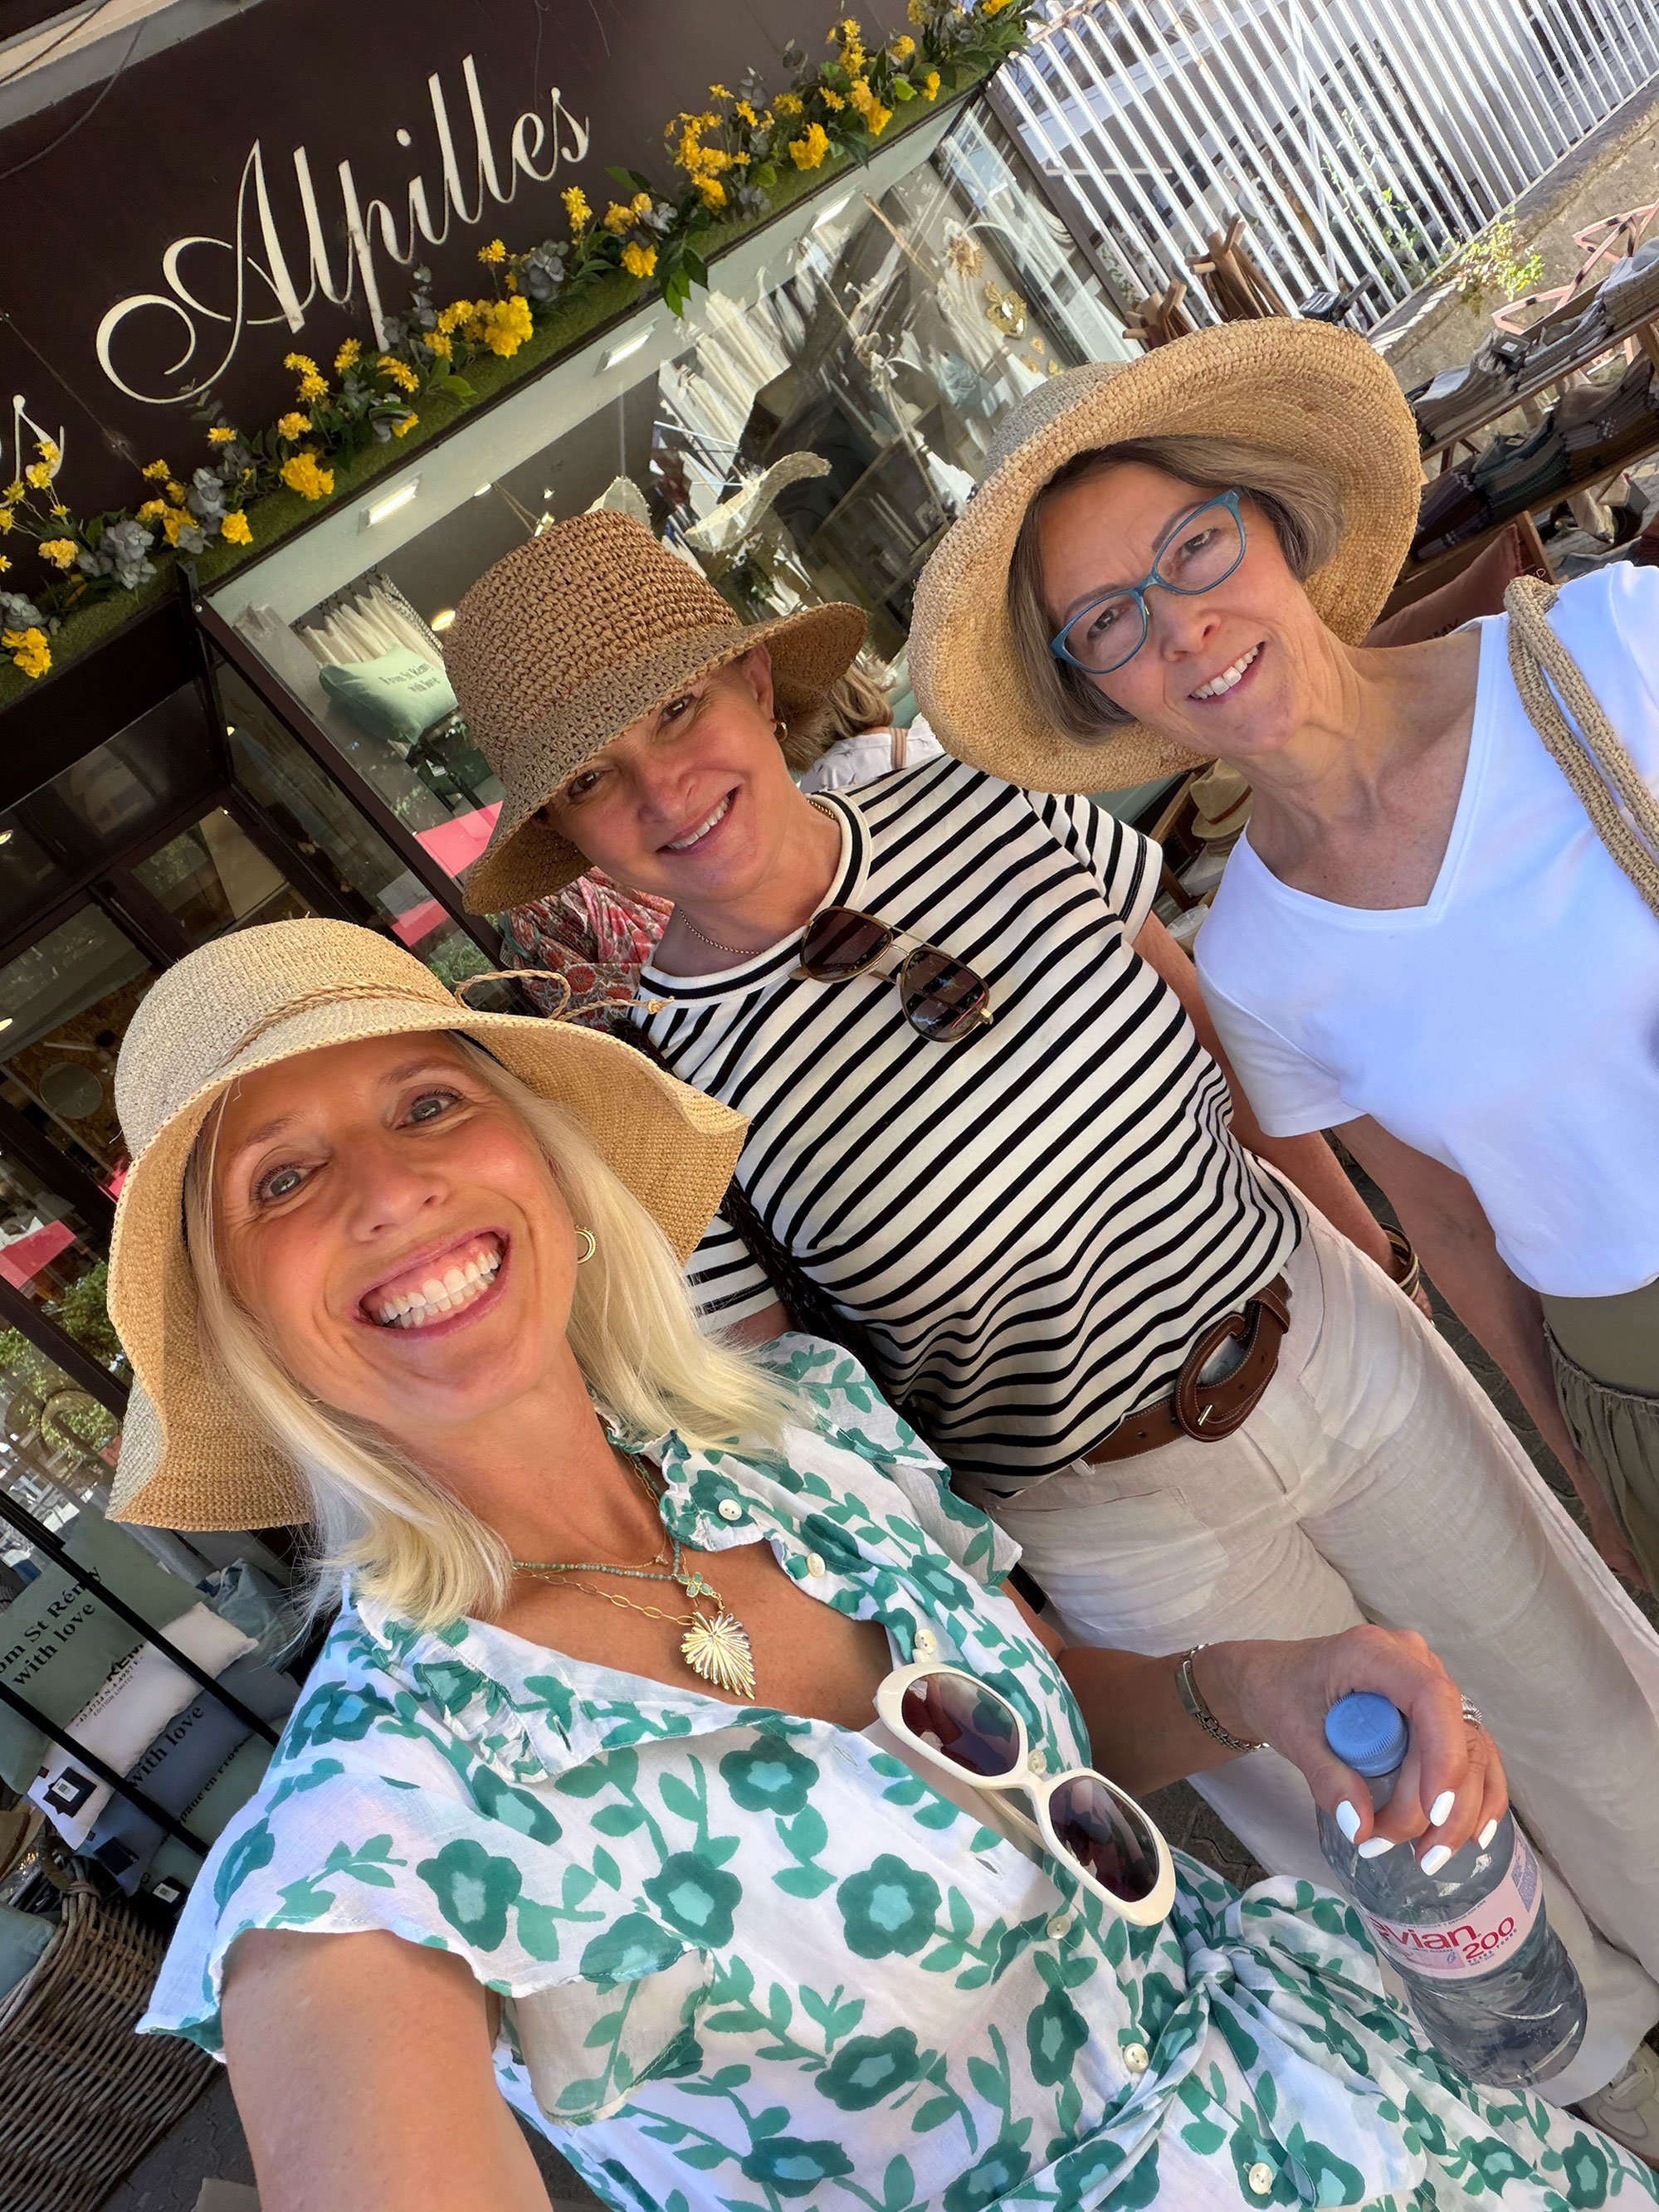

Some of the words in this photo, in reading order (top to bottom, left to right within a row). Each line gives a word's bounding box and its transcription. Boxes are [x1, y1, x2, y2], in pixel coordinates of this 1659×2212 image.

[96, 53, 590, 403] Alpilles
[12, 1644, 58, 1685] with
[53, 1604, 95, 1643] love
[24, 1620, 49, 1643] St
[165, 1707, 204, 1747] love
[1462, 1917, 1515, 1960] 200
